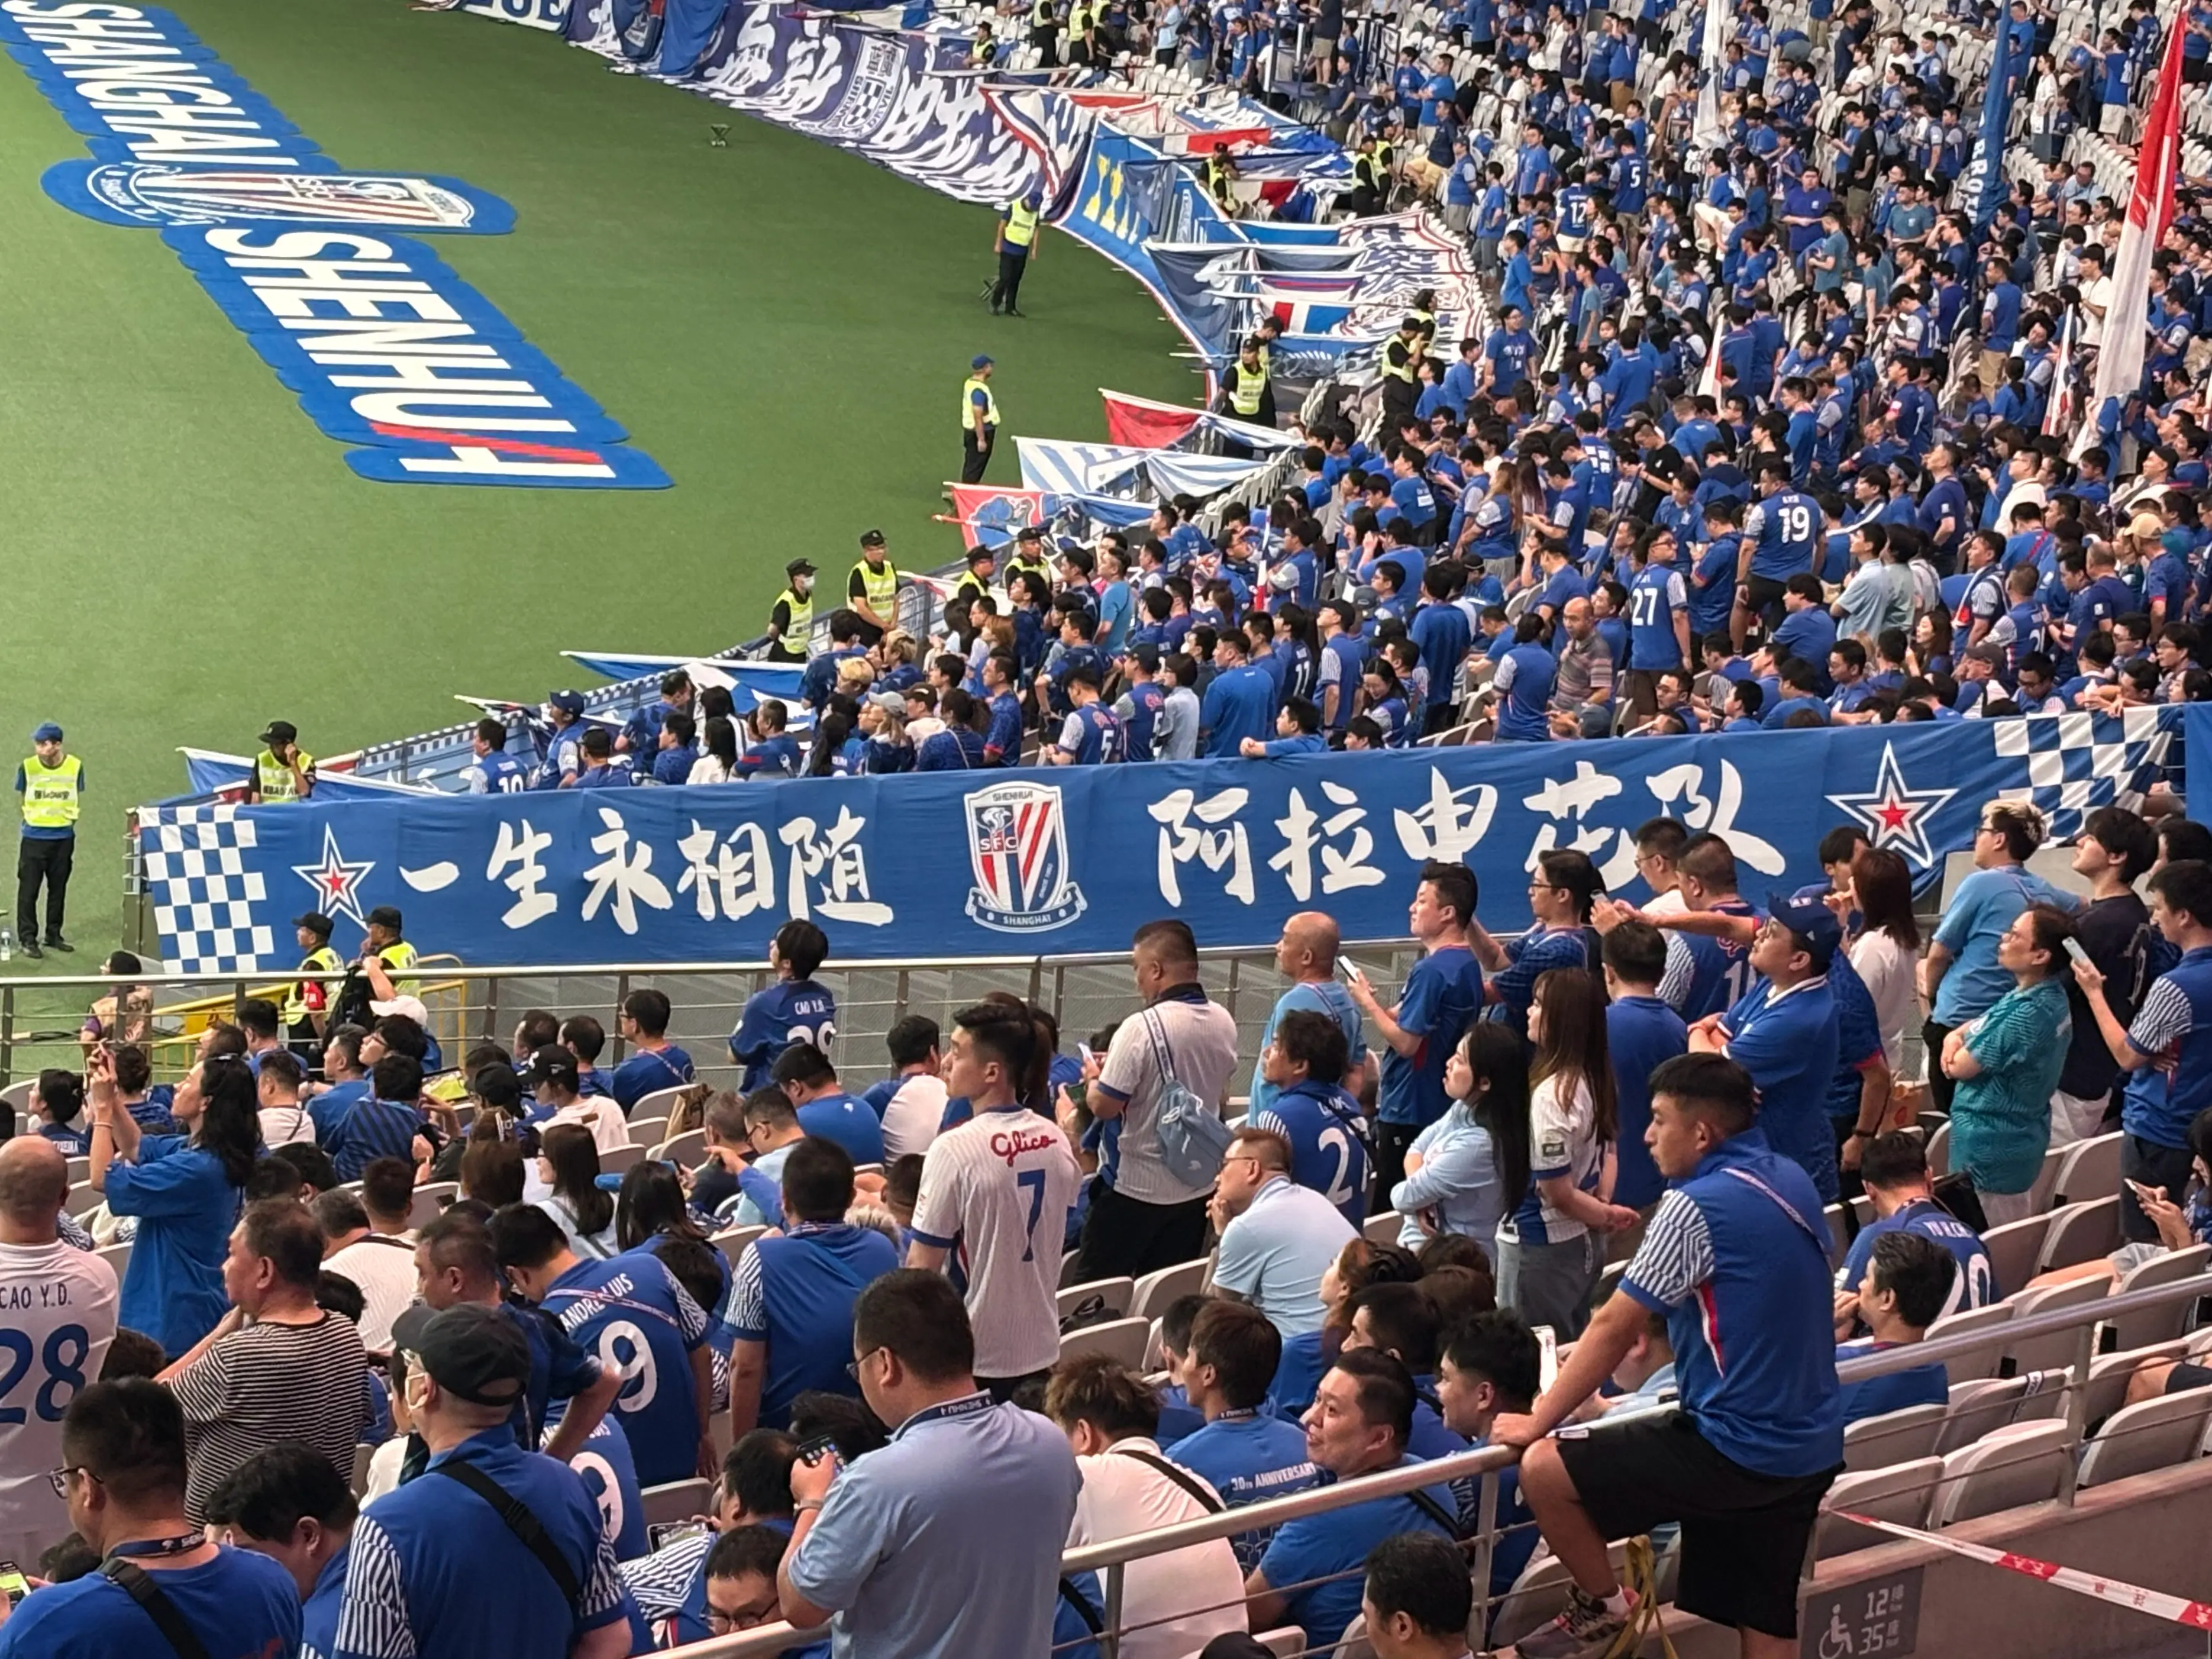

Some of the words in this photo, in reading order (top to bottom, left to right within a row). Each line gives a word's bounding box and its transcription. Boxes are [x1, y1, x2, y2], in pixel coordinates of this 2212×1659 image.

[2, 0, 299, 166] SHANGHAI
[1629, 166, 1641, 188] 5
[1570, 202, 1588, 224] 12
[205, 228, 616, 479] SHENHUA
[1778, 506, 1810, 543] 19
[1632, 588, 1658, 626] 27
[1293, 660, 1309, 697] 11
[1101, 730, 1114, 763] 5
[498, 774, 524, 793] 10
[992, 790, 1033, 802] SHENHUA
[980, 835, 1019, 851] SFC
[1148, 759, 1786, 906] 阿拉申花队
[399, 804, 895, 935] 一生永相随
[1003, 914, 1052, 925] SHANGHAI
[992, 1130, 1058, 1167] Glico
[1018, 1169, 1045, 1260] 7
[0, 1286, 31, 1309] CAO
[40, 1282, 72, 1308] Y.D.
[0, 1324, 89, 1425] 28
[599, 1321, 657, 1413] 9
[1254, 1461, 1316, 1488] ANNIVERSARY
[1864, 1588, 1888, 1620] 12
[1858, 1622, 1885, 1655] 35
